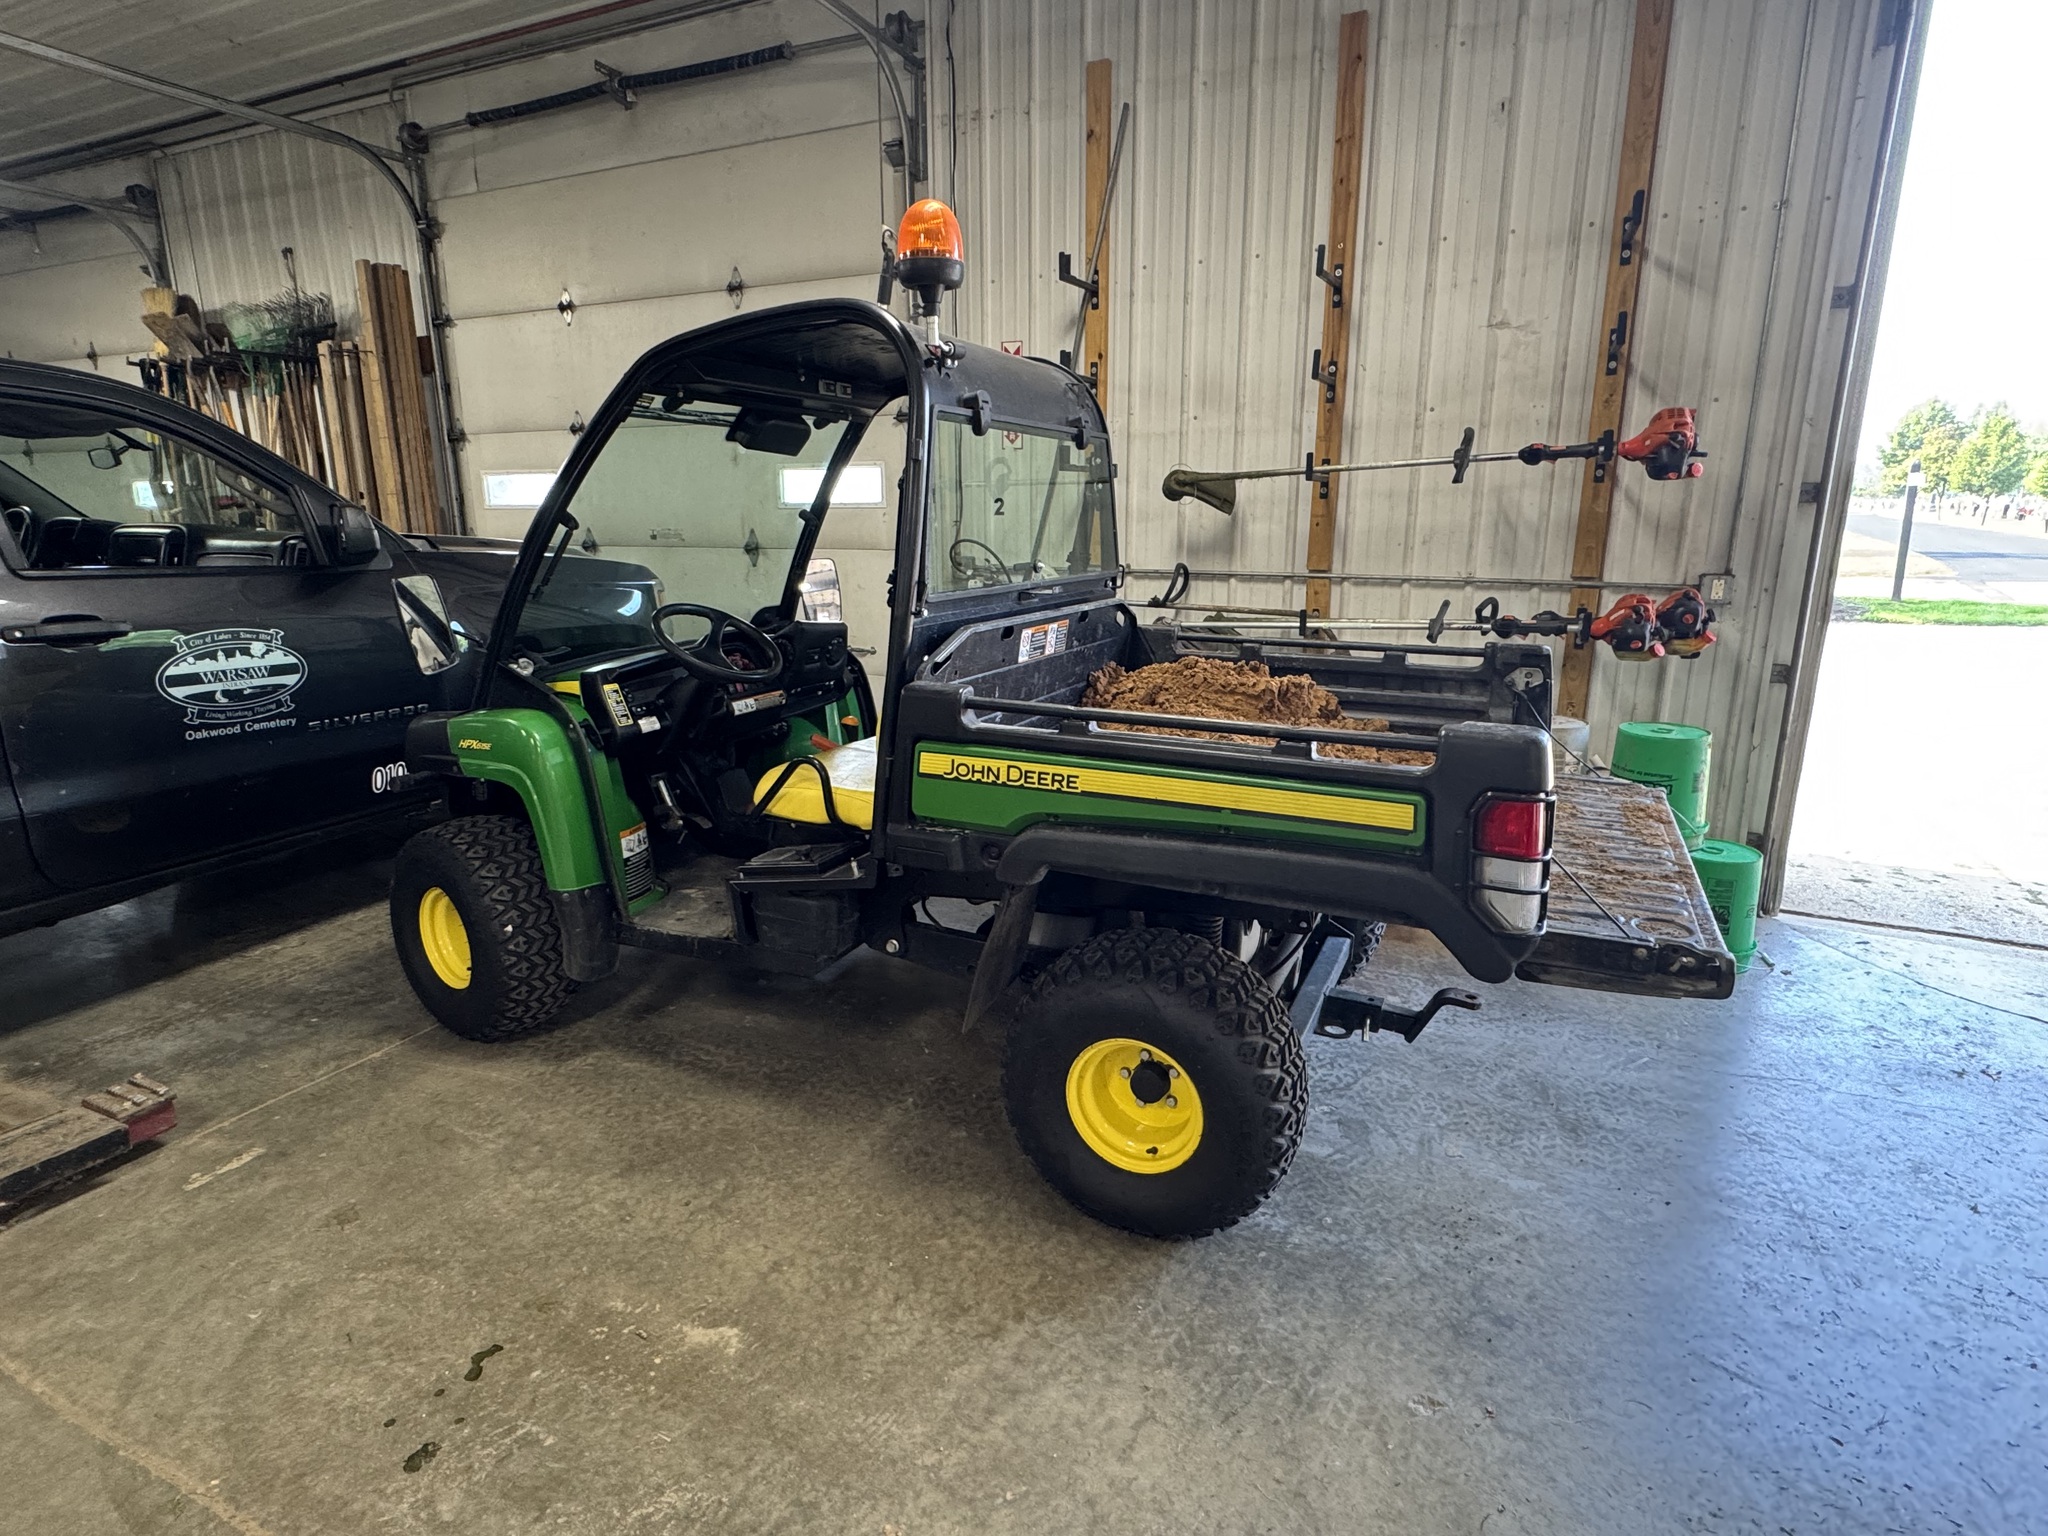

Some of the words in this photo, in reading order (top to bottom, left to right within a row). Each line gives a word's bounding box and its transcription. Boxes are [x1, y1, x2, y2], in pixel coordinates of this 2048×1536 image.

[994, 497, 1005, 516] 2
[189, 638, 204, 647] City
[205, 634, 212, 643] of
[214, 633, 232, 641] Lakes
[240, 631, 257, 640] Since
[199, 665, 271, 685] WARSAW
[222, 680, 254, 689] INDIANA
[308, 703, 429, 732] SILVERADO
[185, 724, 241, 741] Oakwood
[244, 717, 297, 732] Cemetery
[943, 758, 1001, 782] JOHN
[1006, 764, 1080, 790] DEERE
